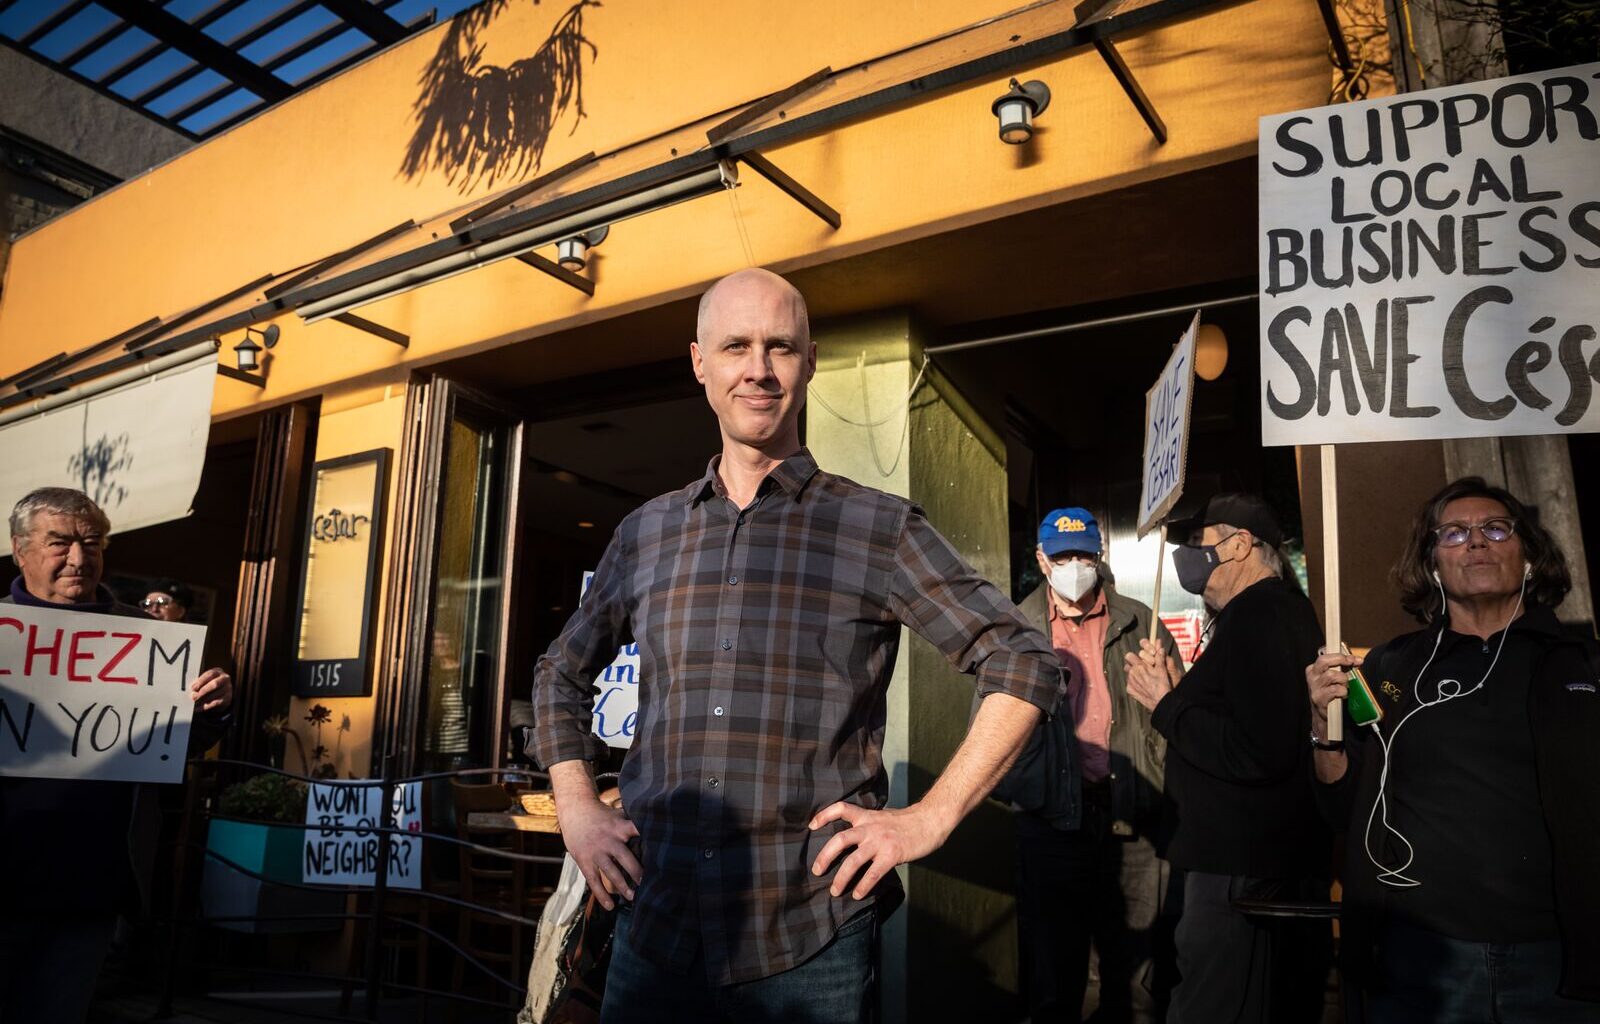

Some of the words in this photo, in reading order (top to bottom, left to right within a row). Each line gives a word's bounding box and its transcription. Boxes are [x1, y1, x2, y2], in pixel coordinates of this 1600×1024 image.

[1272, 73, 1600, 177] SUPPOR
[1331, 154, 1563, 223] LOCAL
[1265, 201, 1600, 297] BUSINESS
[1266, 296, 1441, 420] SAVE
[1150, 356, 1185, 462] SAVE
[310, 663, 342, 687] 1515
[58, 702, 178, 761] YOU!
[318, 815, 344, 837] BE
[380, 784, 415, 815] OU
[306, 839, 411, 877] NEIGHBR?
